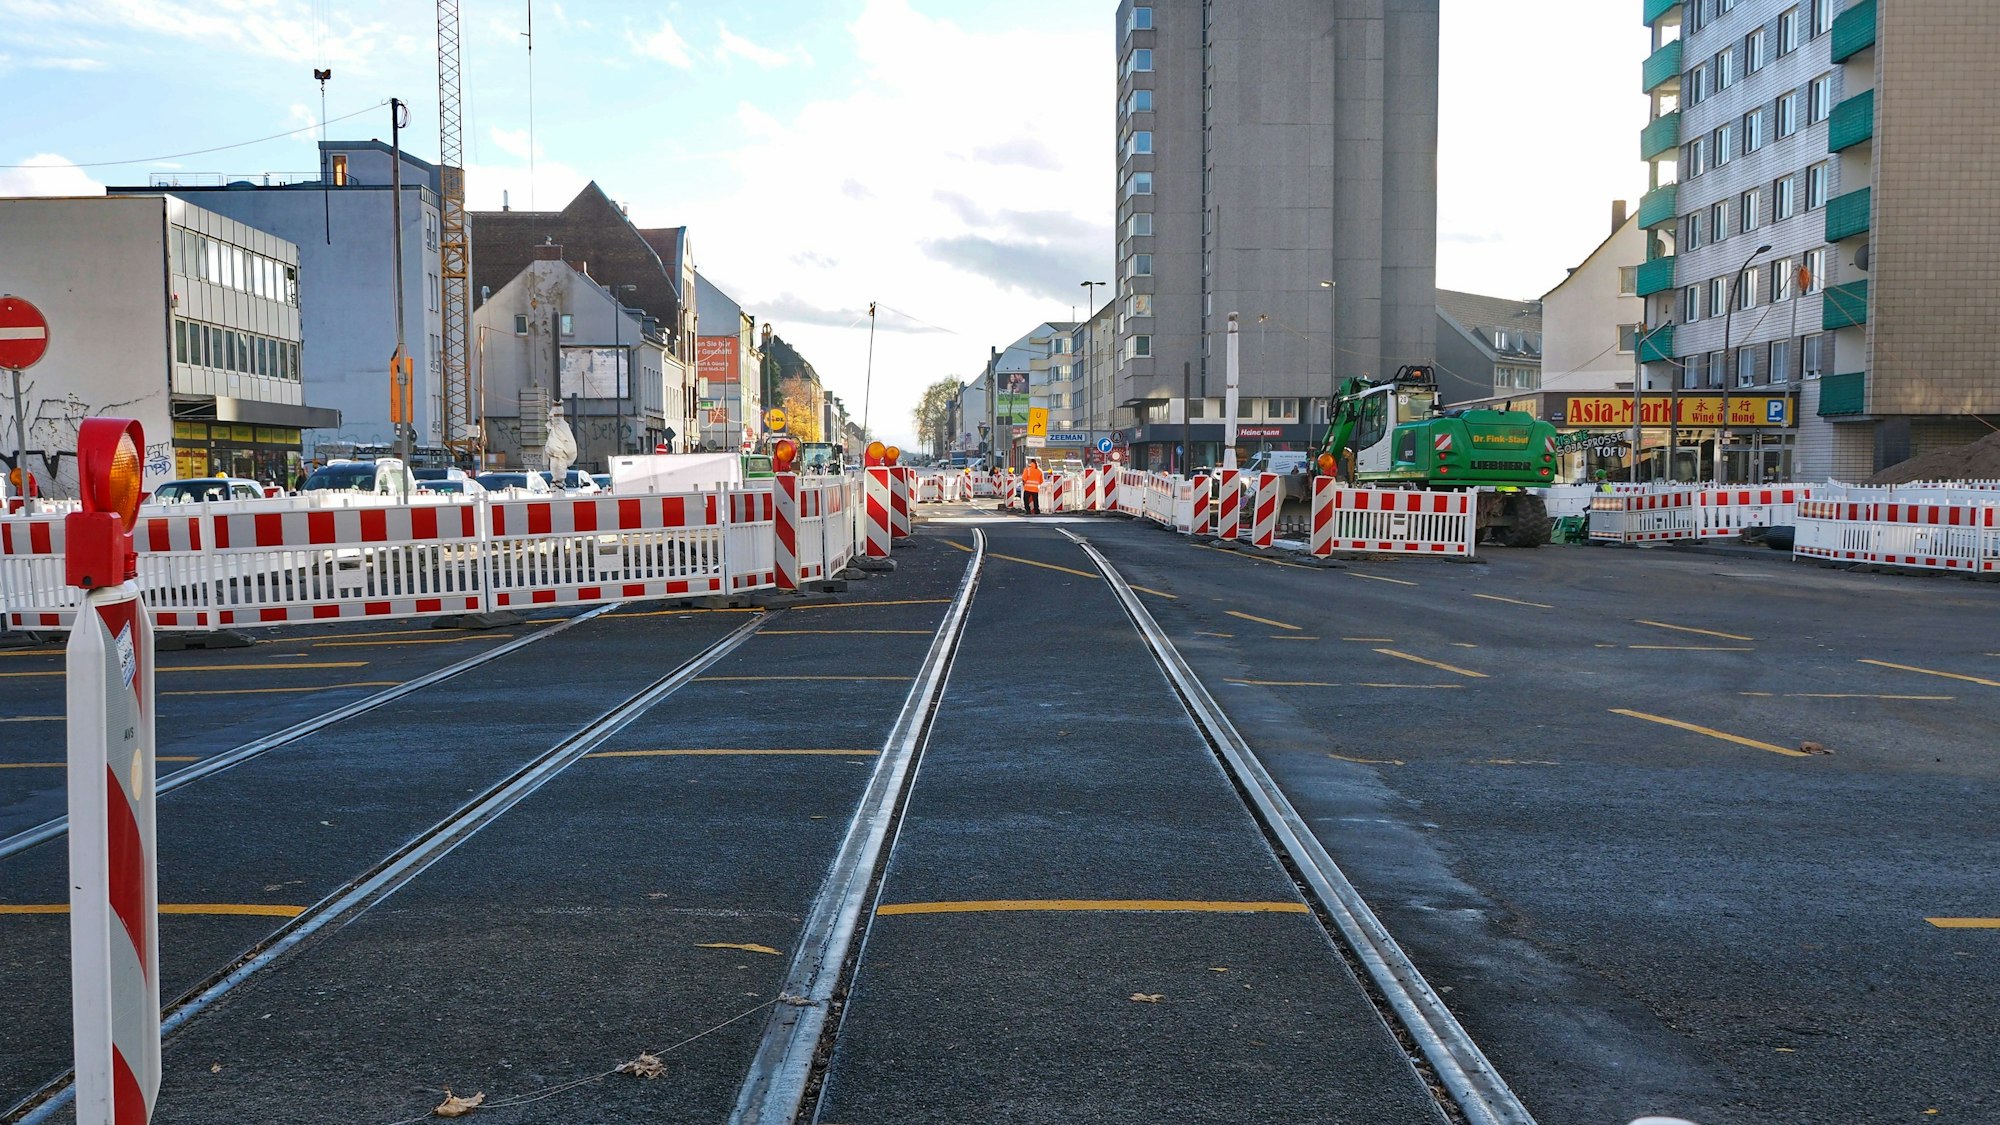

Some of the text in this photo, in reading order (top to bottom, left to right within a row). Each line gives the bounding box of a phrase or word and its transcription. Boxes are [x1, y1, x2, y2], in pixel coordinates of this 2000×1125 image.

[1569, 399, 1684, 422] Asia-Markt
[1770, 401, 1783, 416] P
[1692, 413, 1714, 423] Wing
[1732, 413, 1755, 423] Hong
[1473, 435, 1529, 444] Dr. Fink-Stauf
[1555, 429, 1590, 447] RISCHE
[1556, 431, 1627, 457] SOJASPROSSE
[1595, 446, 1627, 458] TOFU
[1471, 460, 1531, 471] LIEBHERR
[124, 727, 134, 742] AVS
